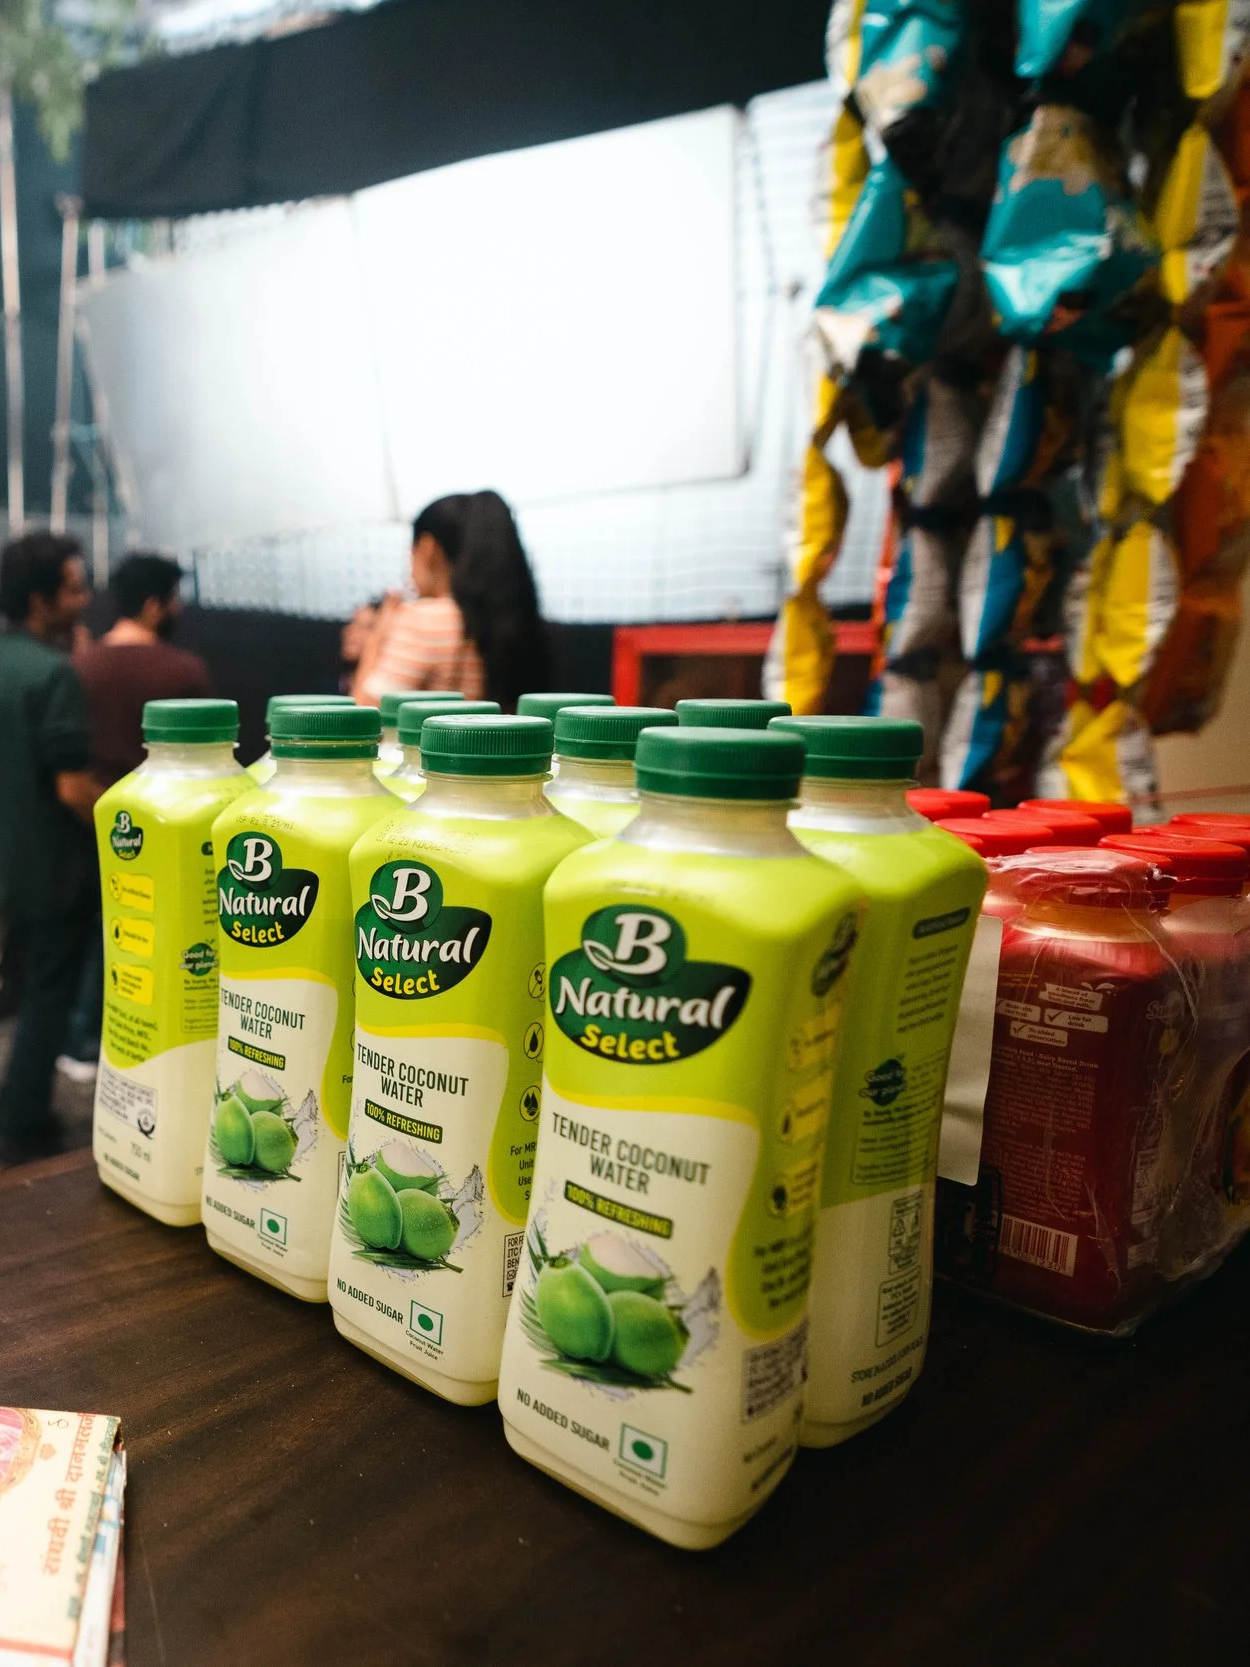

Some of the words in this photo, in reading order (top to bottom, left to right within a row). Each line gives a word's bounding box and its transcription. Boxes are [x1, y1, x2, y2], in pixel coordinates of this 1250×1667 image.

[116, 812, 130, 834] B
[112, 833, 142, 849] Natural
[228, 838, 273, 882] B
[219, 885, 311, 916] Natural
[372, 868, 431, 922] B
[231, 921, 285, 943] Select
[358, 926, 480, 964] Natural
[583, 913, 671, 975] B
[371, 967, 440, 995] Select
[221, 988, 252, 1014] TENDER
[255, 1001, 306, 1030] COCONUT
[555, 975, 736, 1029] Natural
[240, 1014, 272, 1040] WATER
[580, 1023, 679, 1060] Select
[245, 1046, 284, 1068] REFRESHING
[357, 1043, 395, 1078] TENDER
[399, 1062, 469, 1096] COCONUT
[381, 1075, 424, 1108] WATER
[366, 1102, 385, 1122] 100%
[386, 1112, 441, 1141] REFRESHING
[510, 1145, 523, 1156] For
[524, 1141, 536, 1154] MR
[552, 1112, 612, 1156] TENDER
[617, 1139, 711, 1185] COCONUT
[518, 1176, 532, 1186] Use
[519, 1160, 534, 1171] Unit
[590, 1154, 651, 1195] WATER
[507, 1247, 519, 1258] ITC
[508, 1236, 519, 1247] FOR
[507, 1257, 520, 1269] BEN
[337, 1278, 346, 1293] NO
[347, 1286, 374, 1307] ADDED
[375, 1300, 404, 1325] SUGAR
[517, 1388, 531, 1407] NO
[532, 1399, 568, 1429] ADDED
[570, 1420, 611, 1452] SUGAR
